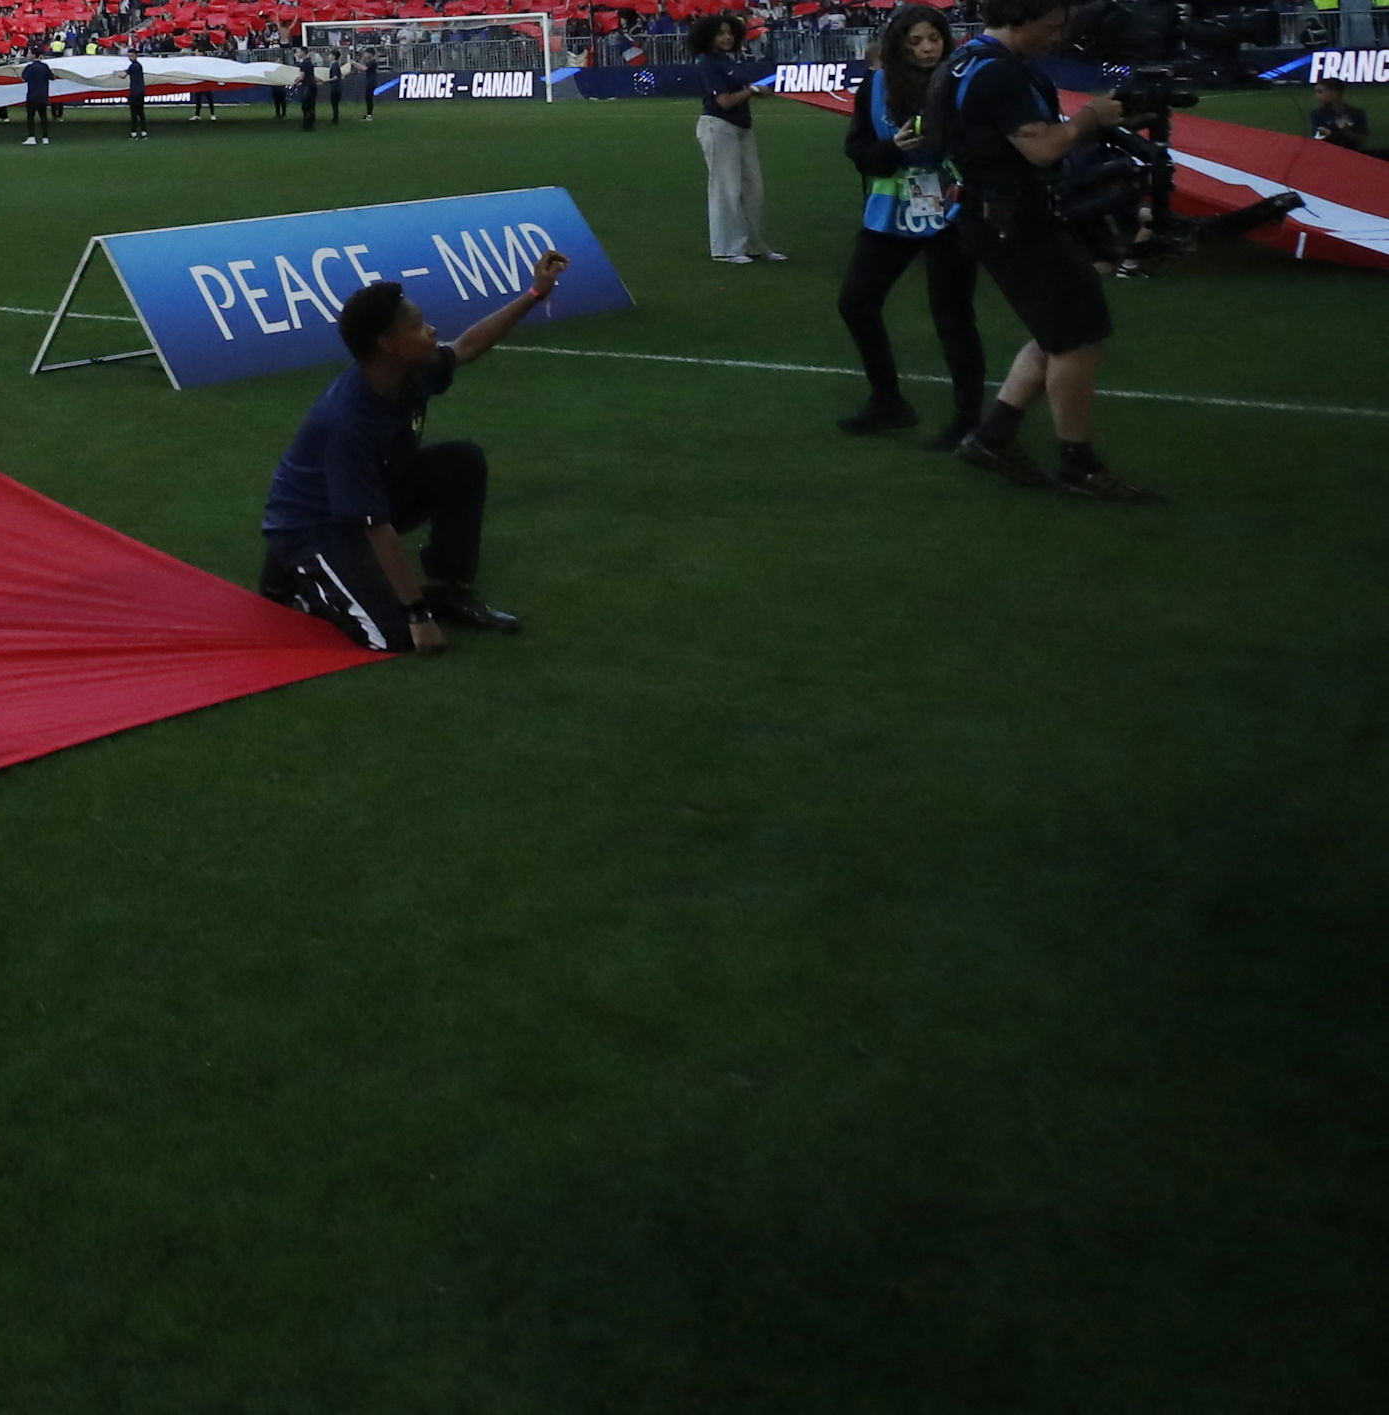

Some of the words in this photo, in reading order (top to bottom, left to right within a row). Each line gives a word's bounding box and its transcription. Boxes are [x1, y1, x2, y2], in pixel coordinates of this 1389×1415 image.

[398, 73, 455, 99] FRANCE
[471, 71, 534, 98] CANADA
[774, 63, 847, 93] FRANCE
